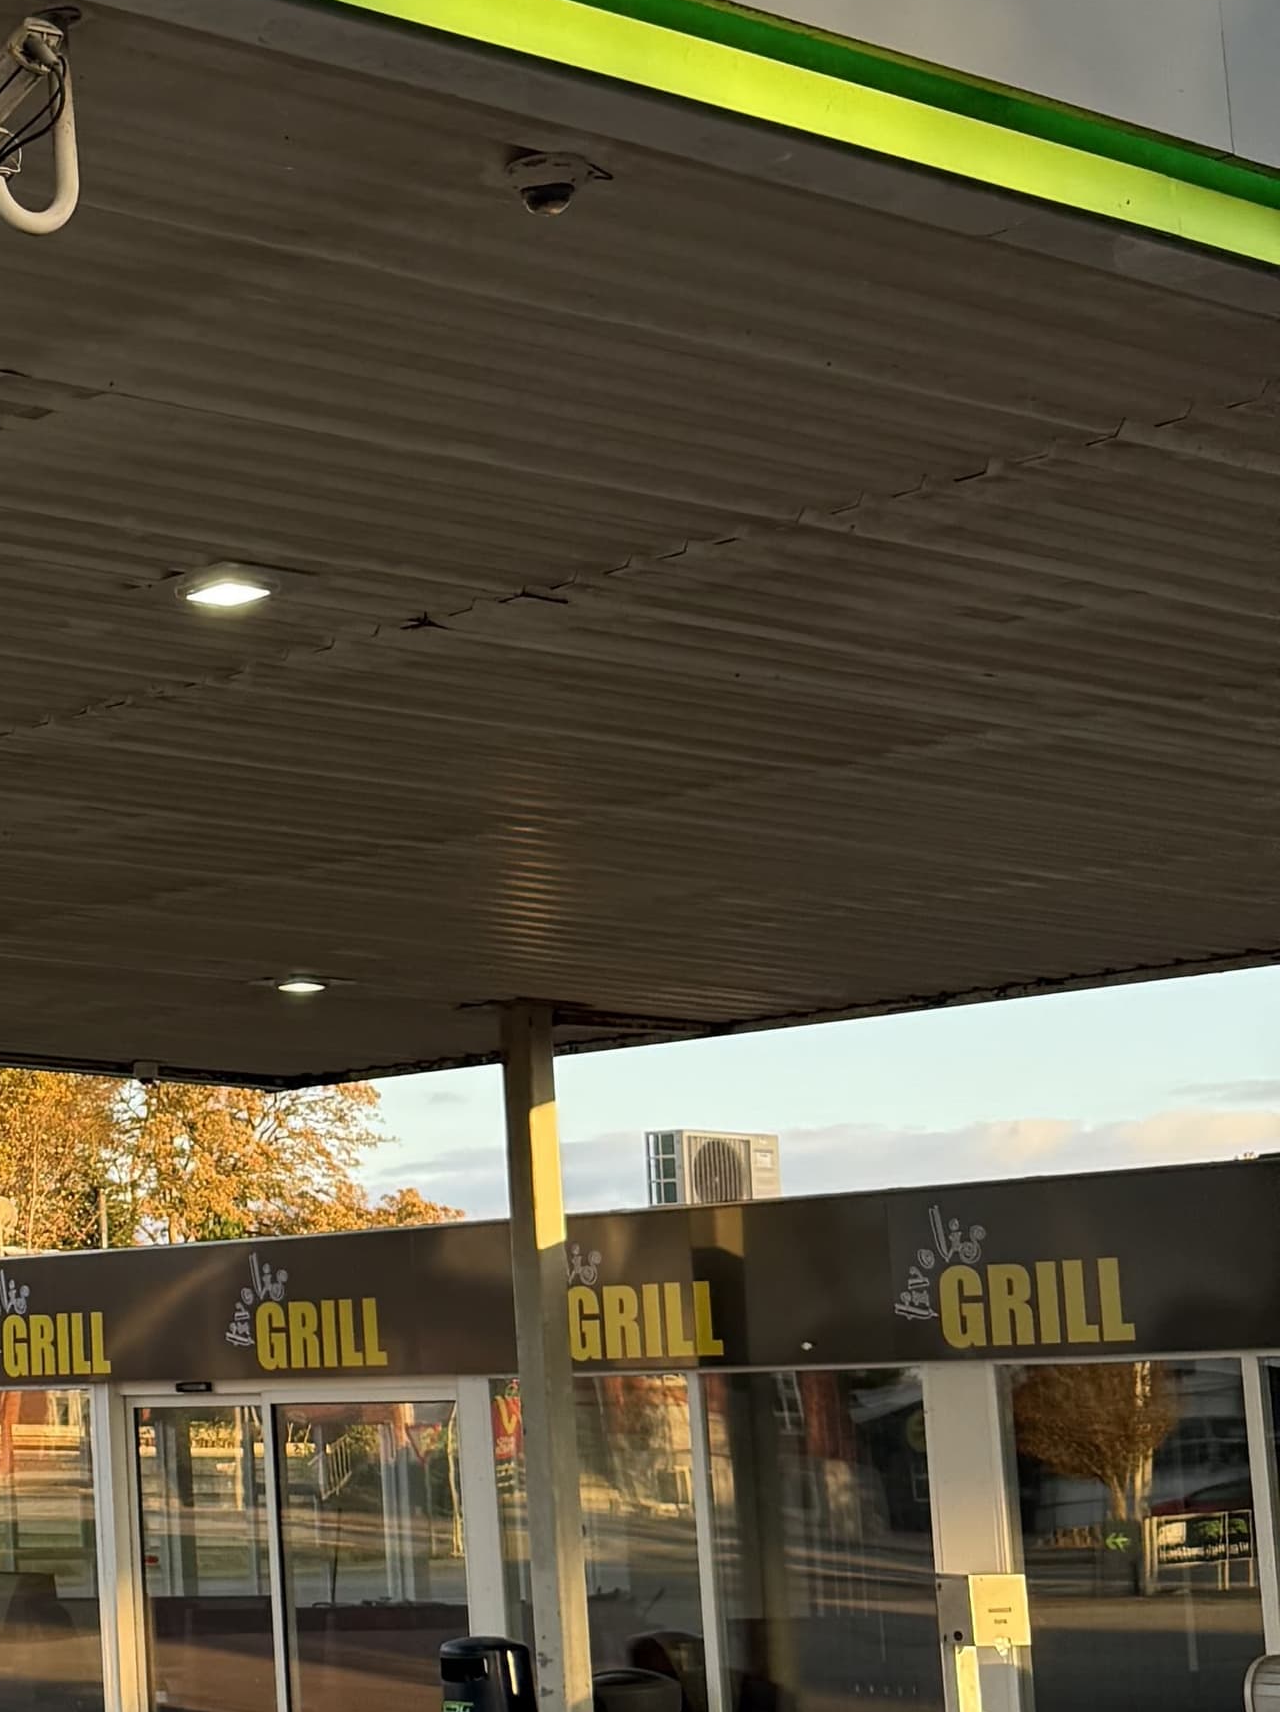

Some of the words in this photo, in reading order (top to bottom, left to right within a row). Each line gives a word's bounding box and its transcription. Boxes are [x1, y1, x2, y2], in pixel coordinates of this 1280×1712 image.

[255, 1297, 388, 1371] GRILL
[567, 1280, 725, 1362] GRILL
[940, 1257, 1136, 1349] GRILL
[2, 1311, 112, 1378] GRILL
